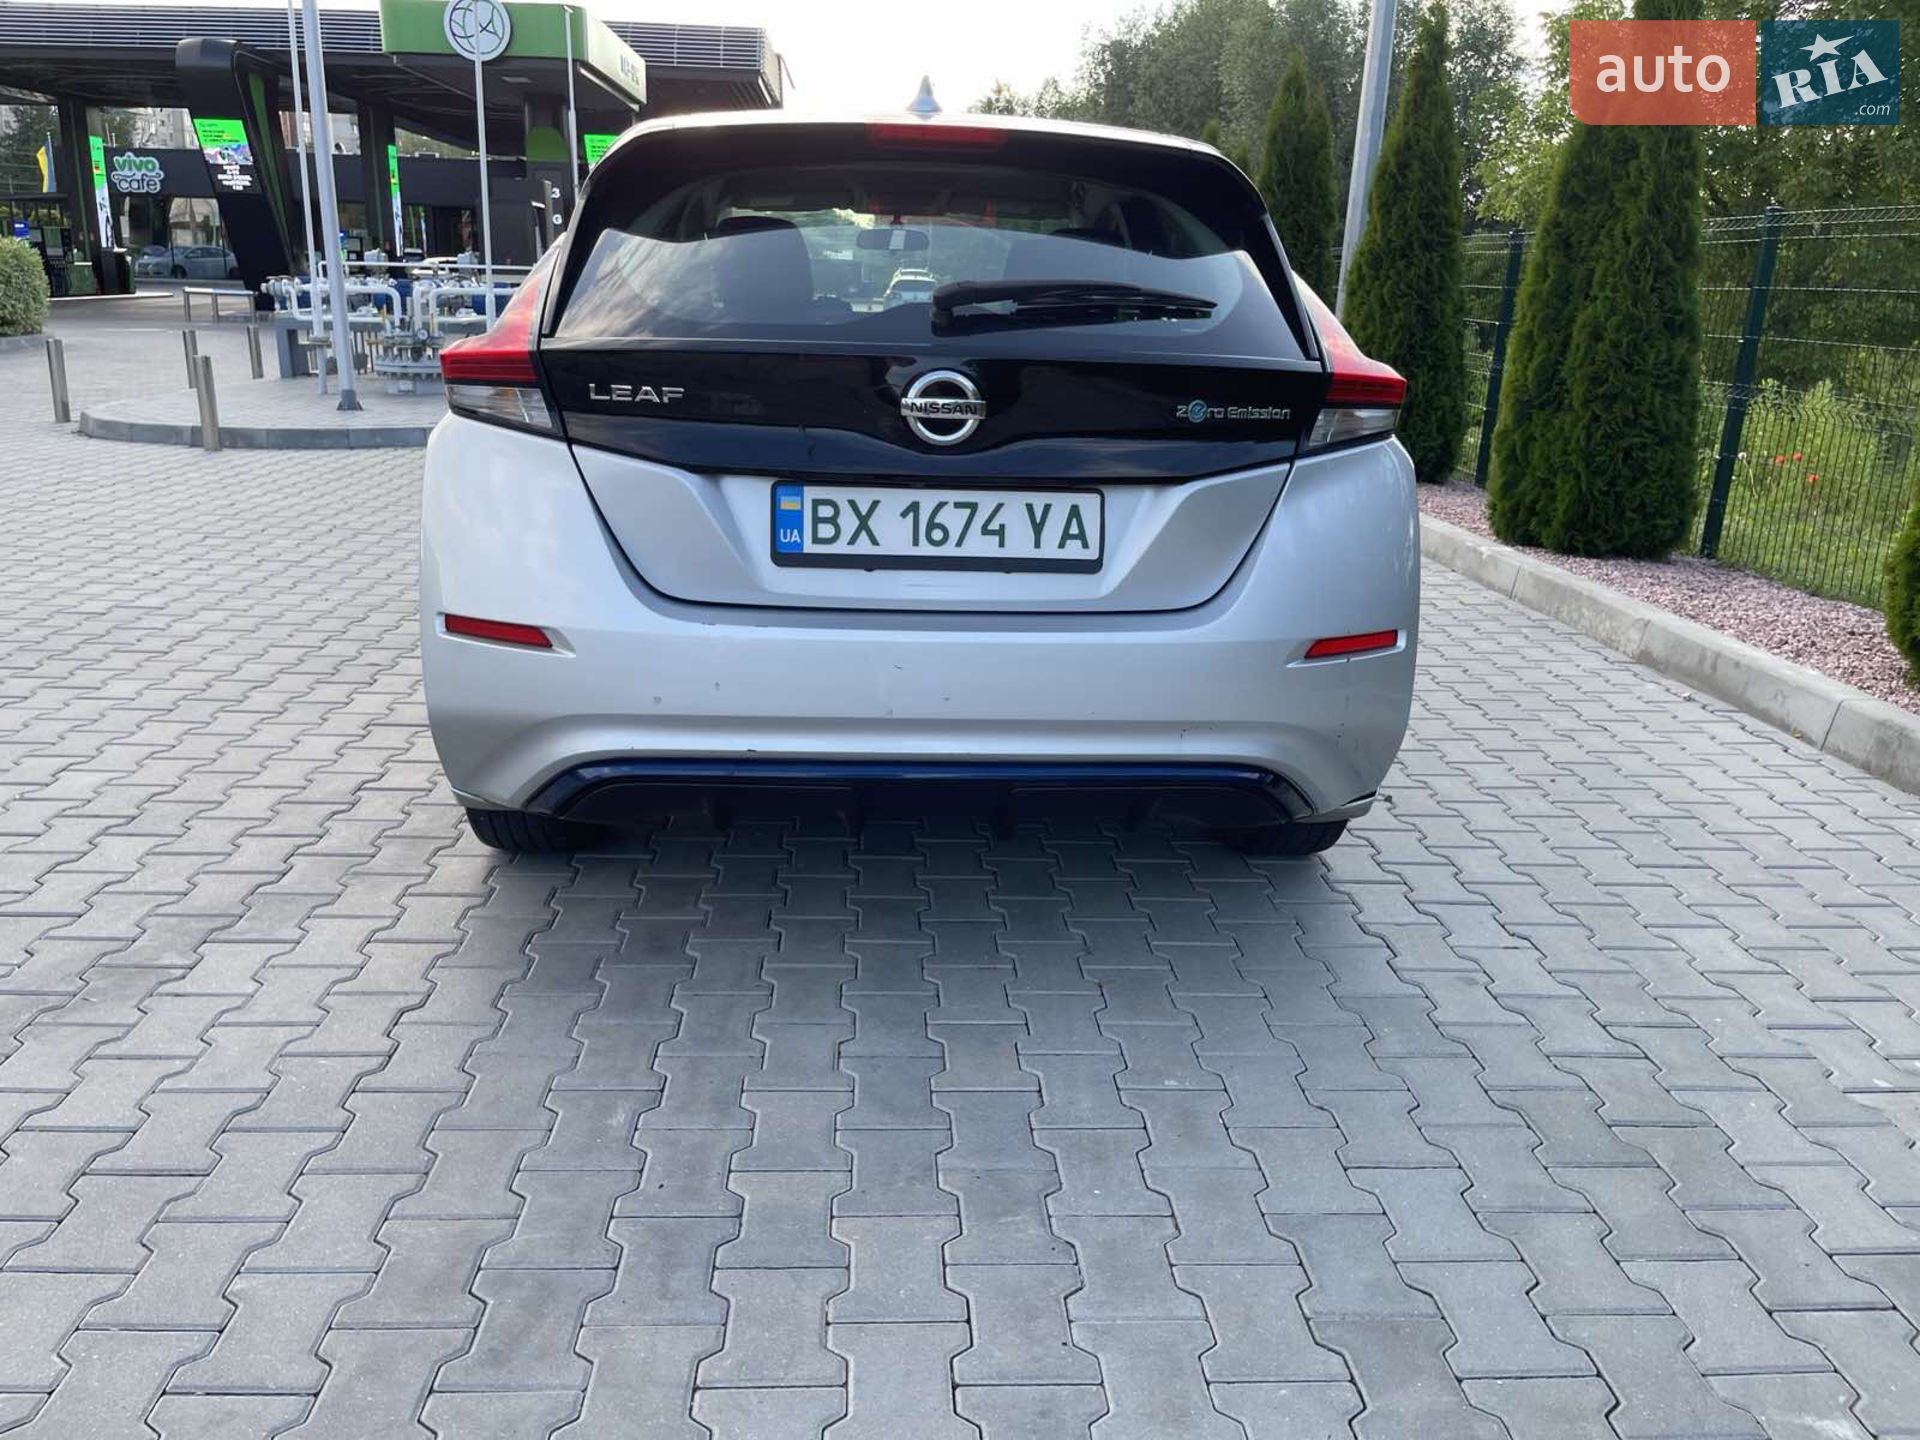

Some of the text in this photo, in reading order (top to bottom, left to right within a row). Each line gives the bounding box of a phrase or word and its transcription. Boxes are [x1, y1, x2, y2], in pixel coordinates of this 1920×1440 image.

[114, 154, 158, 172] vivo
[588, 383, 685, 404] LEAF
[910, 402, 978, 416] NISSAN
[810, 498, 1090, 550] BX 1674 YA
[780, 528, 801, 544] UA
